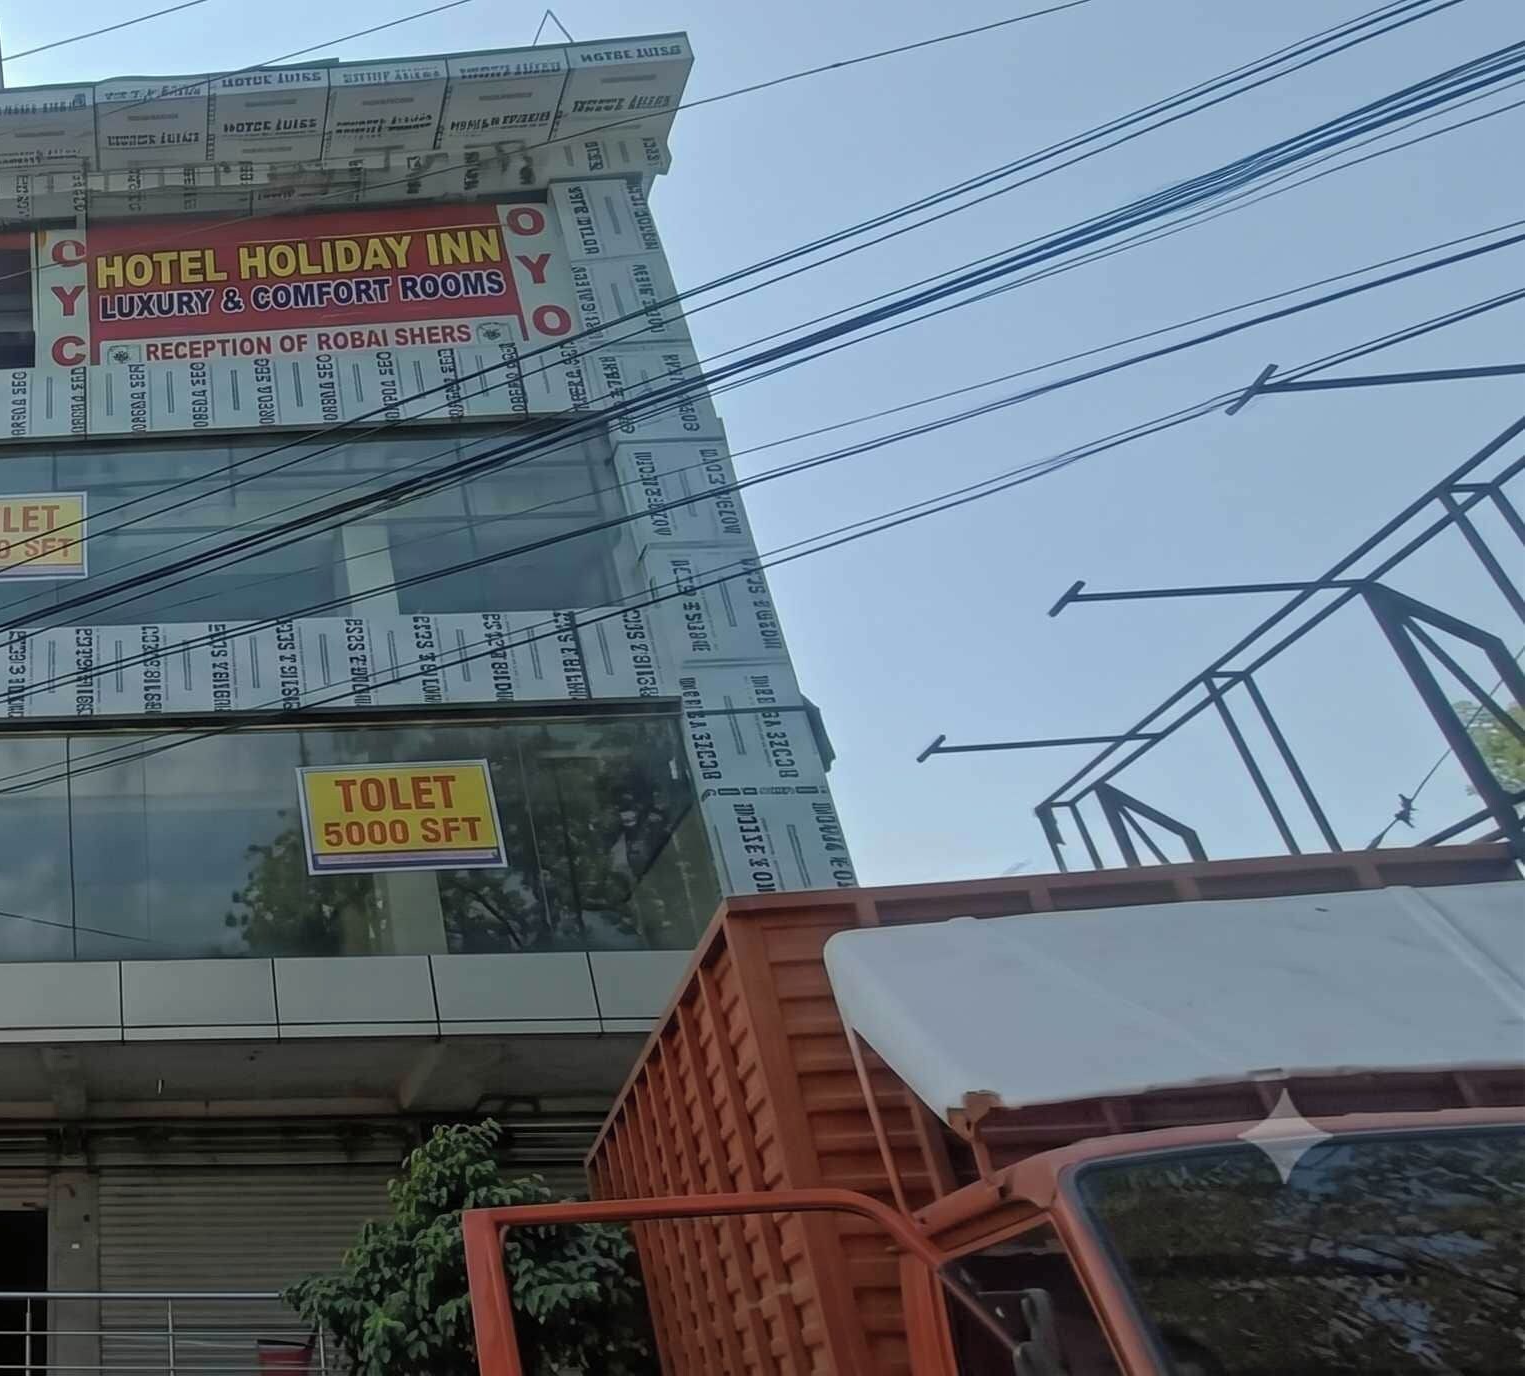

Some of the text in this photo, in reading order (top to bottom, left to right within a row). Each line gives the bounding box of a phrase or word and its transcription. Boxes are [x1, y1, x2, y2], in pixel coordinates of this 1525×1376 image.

[96, 228, 504, 290] HOTEL HOLIDAY INN
[506, 207, 572, 336] OYO
[100, 271, 504, 320] LUXURY & COMFORT ROOMS
[145, 324, 472, 361] RECEPTION OF ROBAI SHERS
[24, 538, 74, 558] SFT
[334, 775, 456, 813] TOLET
[324, 817, 481, 847] 5000 SFT
